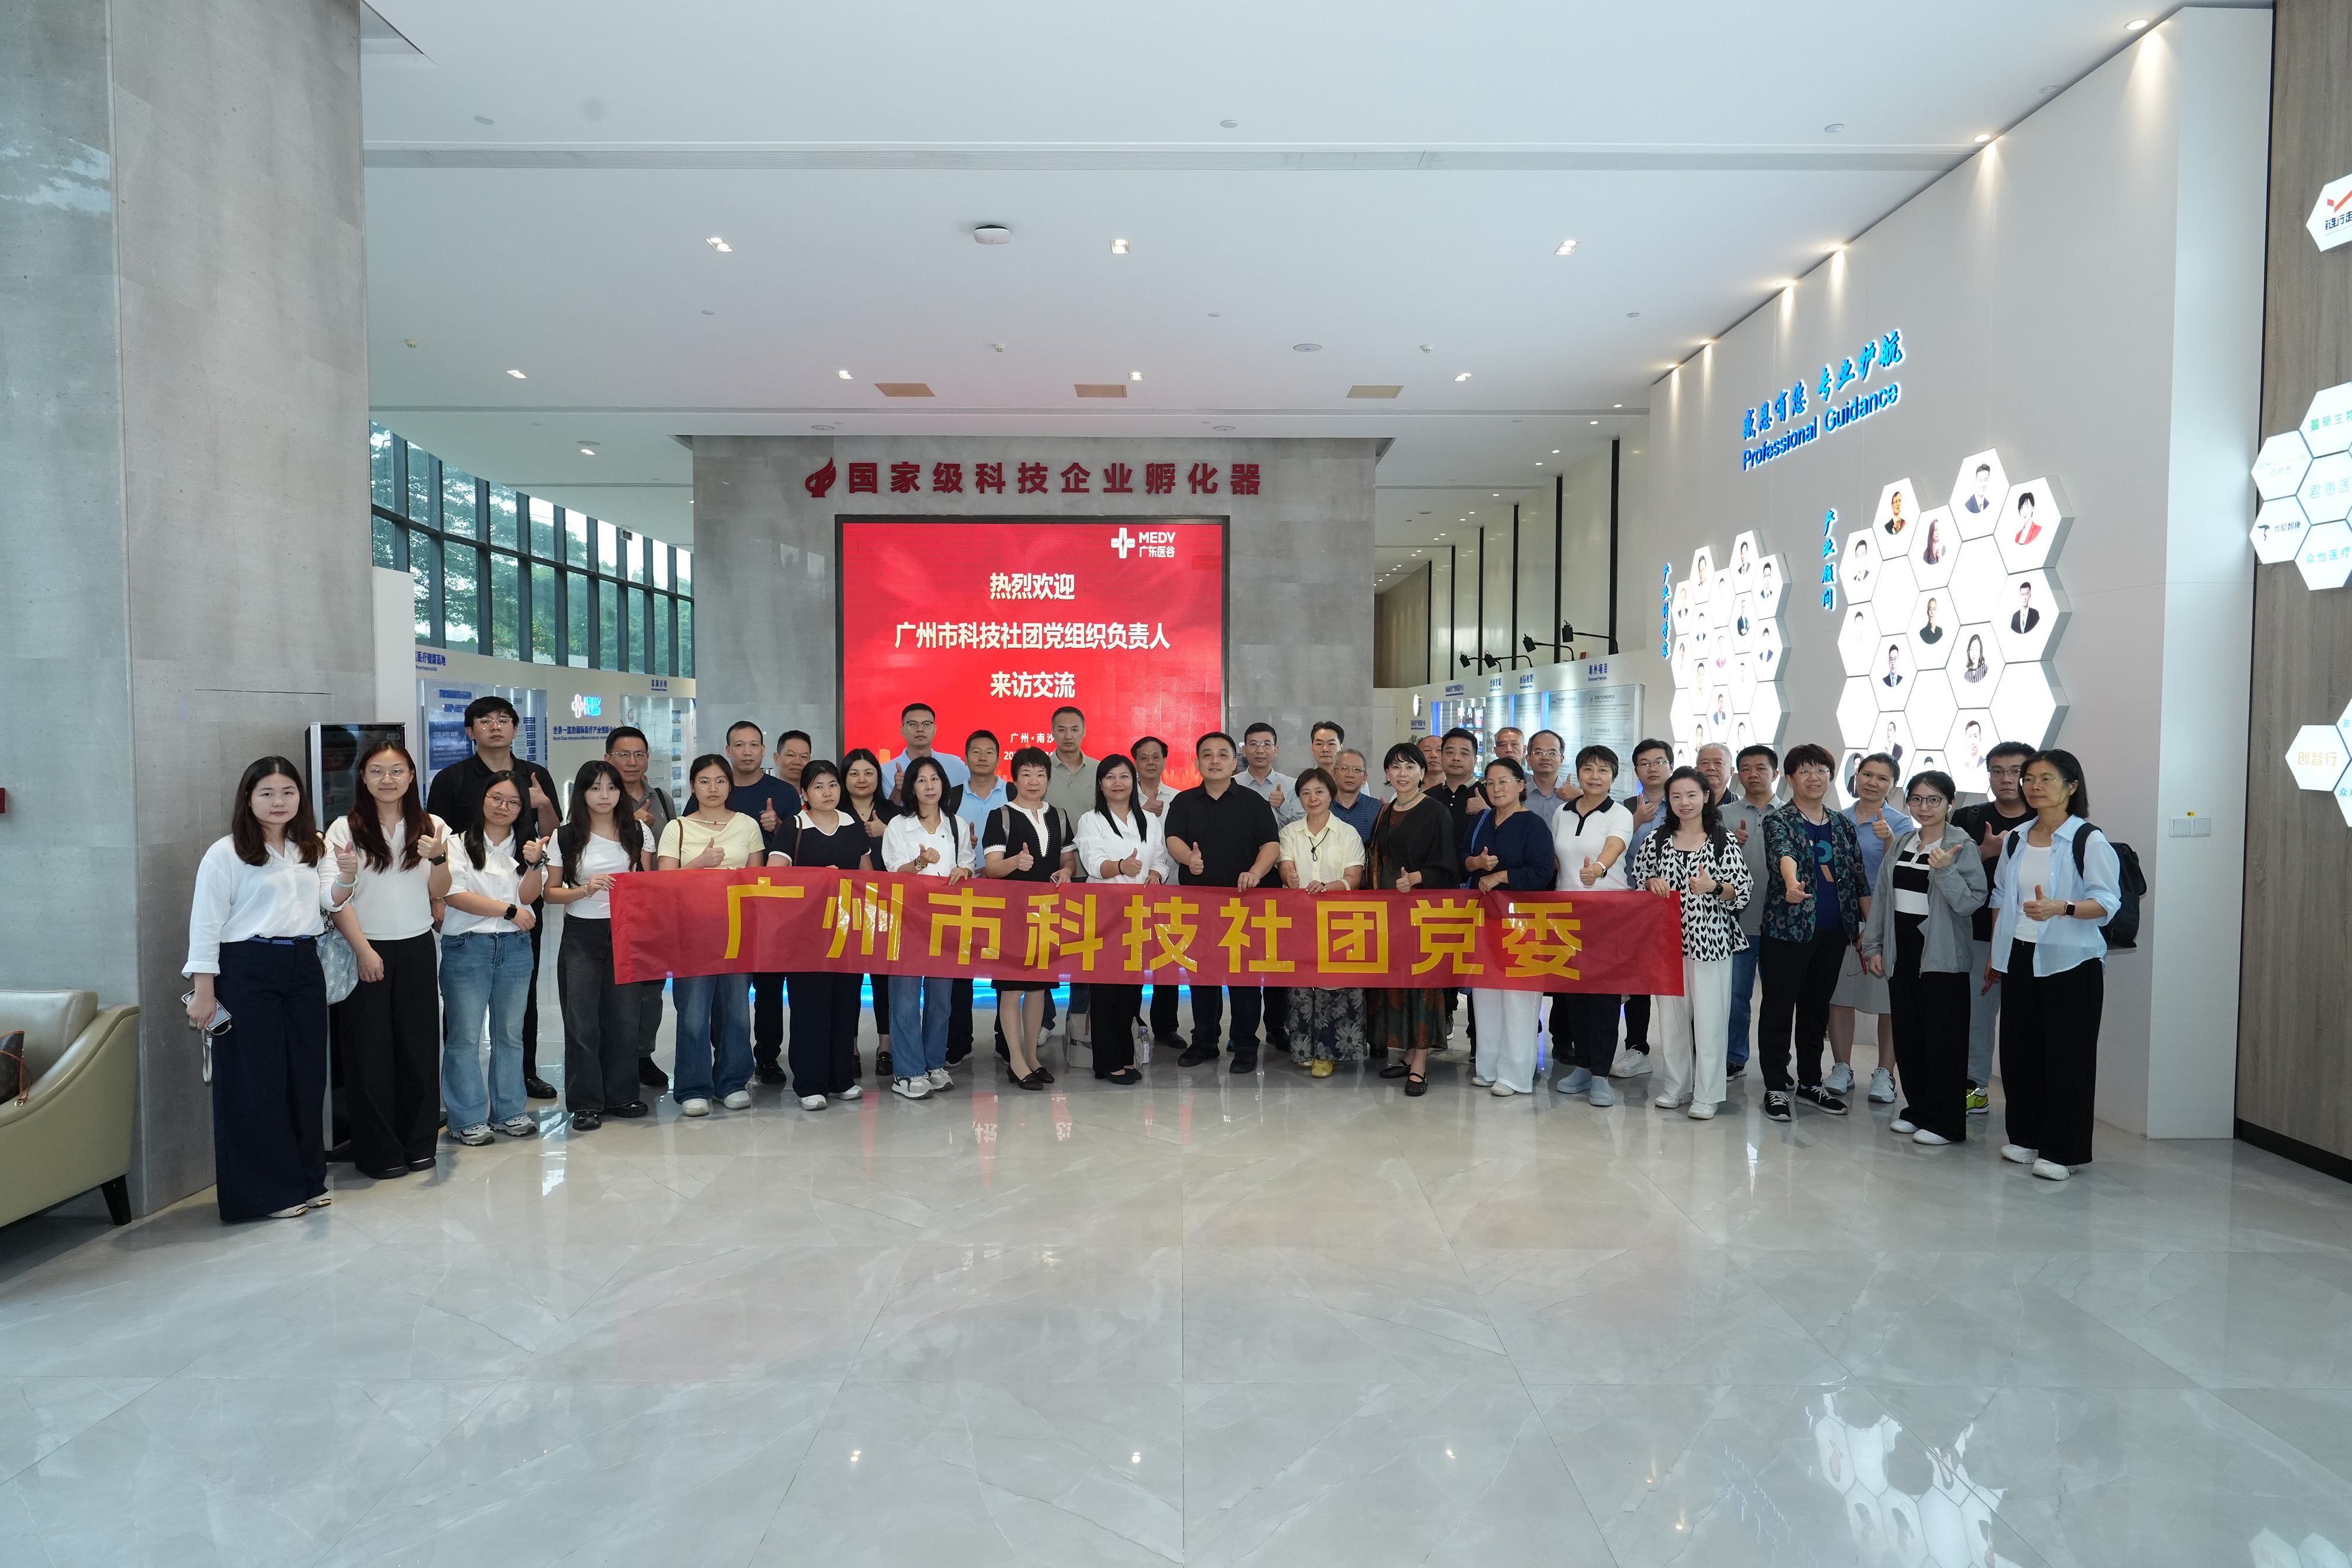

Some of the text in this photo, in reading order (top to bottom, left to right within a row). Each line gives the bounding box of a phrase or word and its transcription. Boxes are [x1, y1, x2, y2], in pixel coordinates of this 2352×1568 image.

[1743, 384, 1899, 470] Professional Guidance
[848, 462, 1261, 495] 国家级科技企业孵化器
[1139, 532, 1175, 543] MEDV
[1139, 546, 1175, 558] 广东医谷
[990, 572, 1075, 600] 热烈欢迎
[895, 622, 1171, 650] 广州市科技社团党组织负责人
[990, 671, 1075, 698] 来访交流
[2298, 752, 2337, 766] 创智行
[724, 876, 1583, 981] 广州市科技社团党委
